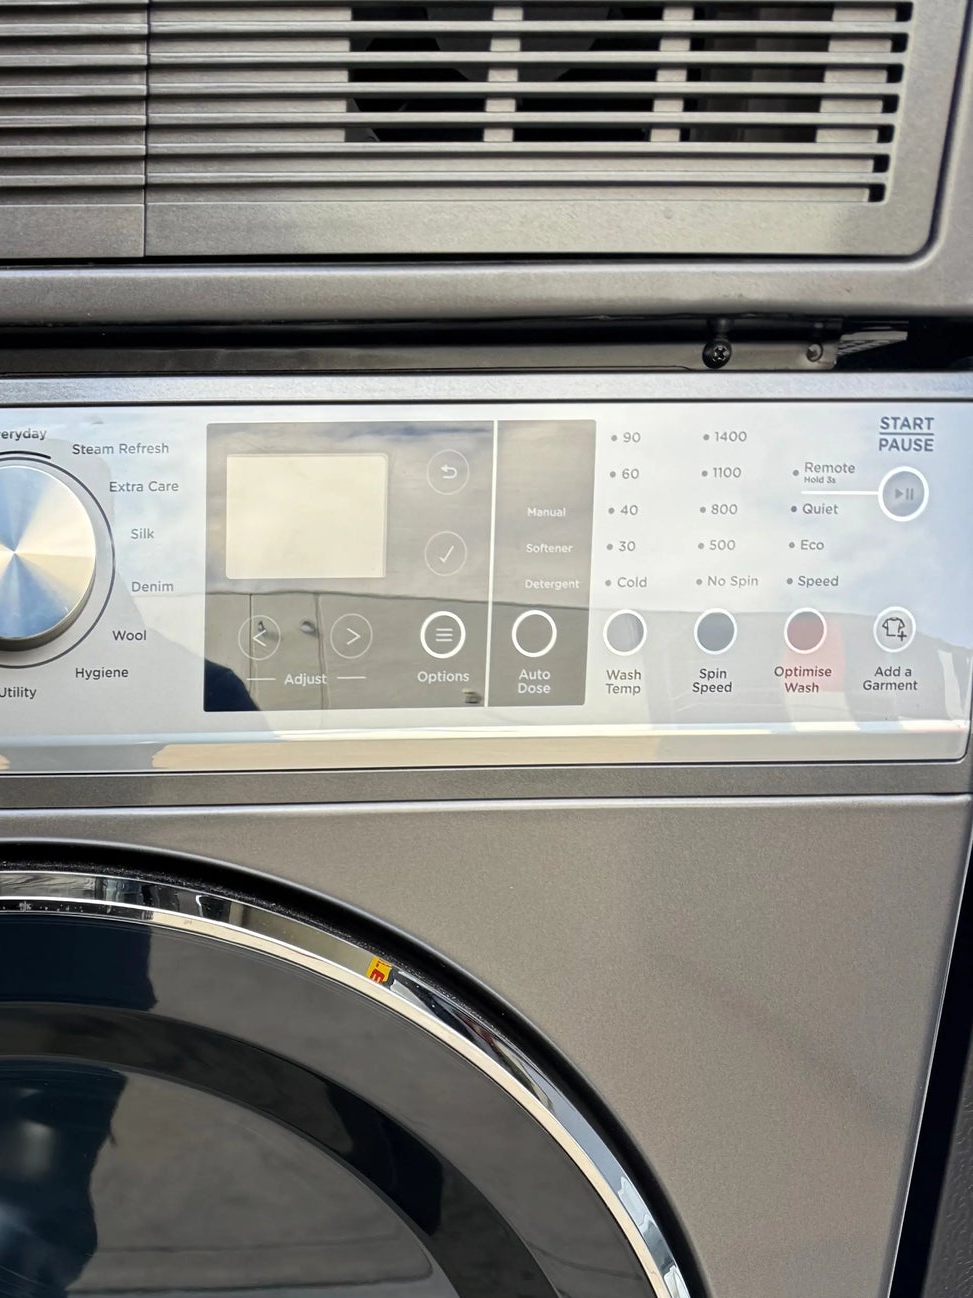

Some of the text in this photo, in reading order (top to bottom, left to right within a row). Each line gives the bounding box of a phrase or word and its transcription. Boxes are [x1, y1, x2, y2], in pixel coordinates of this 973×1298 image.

[879, 416, 935, 430] START
[622, 432, 641, 443] 90
[714, 431, 747, 443] 1400
[72, 442, 170, 456] Steam Refresh
[878, 438, 934, 452] PAUSE
[621, 468, 640, 480] 60
[712, 467, 742, 479] 1100
[804, 462, 855, 475] Remote
[804, 476, 836, 484] Hold 3s
[109, 481, 180, 493] Extra Care
[527, 507, 566, 518] Manual
[620, 505, 639, 516] 40
[710, 504, 738, 515] 800
[802, 503, 839, 516] Quiet
[130, 528, 155, 540] Silk
[526, 543, 573, 554] Softener
[618, 541, 636, 552] 30
[709, 539, 736, 551] 500
[800, 539, 825, 551] Eco
[131, 581, 174, 593] Denim
[525, 579, 579, 590] Detergent
[617, 576, 647, 588] Cold
[707, 576, 759, 590] No Spin
[797, 575, 839, 589] Speed
[112, 630, 147, 641] Wool
[75, 667, 129, 681] Hygiene
[417, 670, 470, 683] Options
[519, 669, 551, 681] Auto
[606, 669, 642, 681] Wash
[699, 668, 727, 682] Spin
[774, 665, 832, 679] Optimise
[874, 666, 912, 678] Add a
[284, 672, 327, 686] Adjust
[517, 683, 551, 694] Dose
[605, 683, 641, 696] Temp
[692, 681, 733, 695] Speed
[784, 681, 820, 693] Wash
[862, 680, 918, 692] Garment
